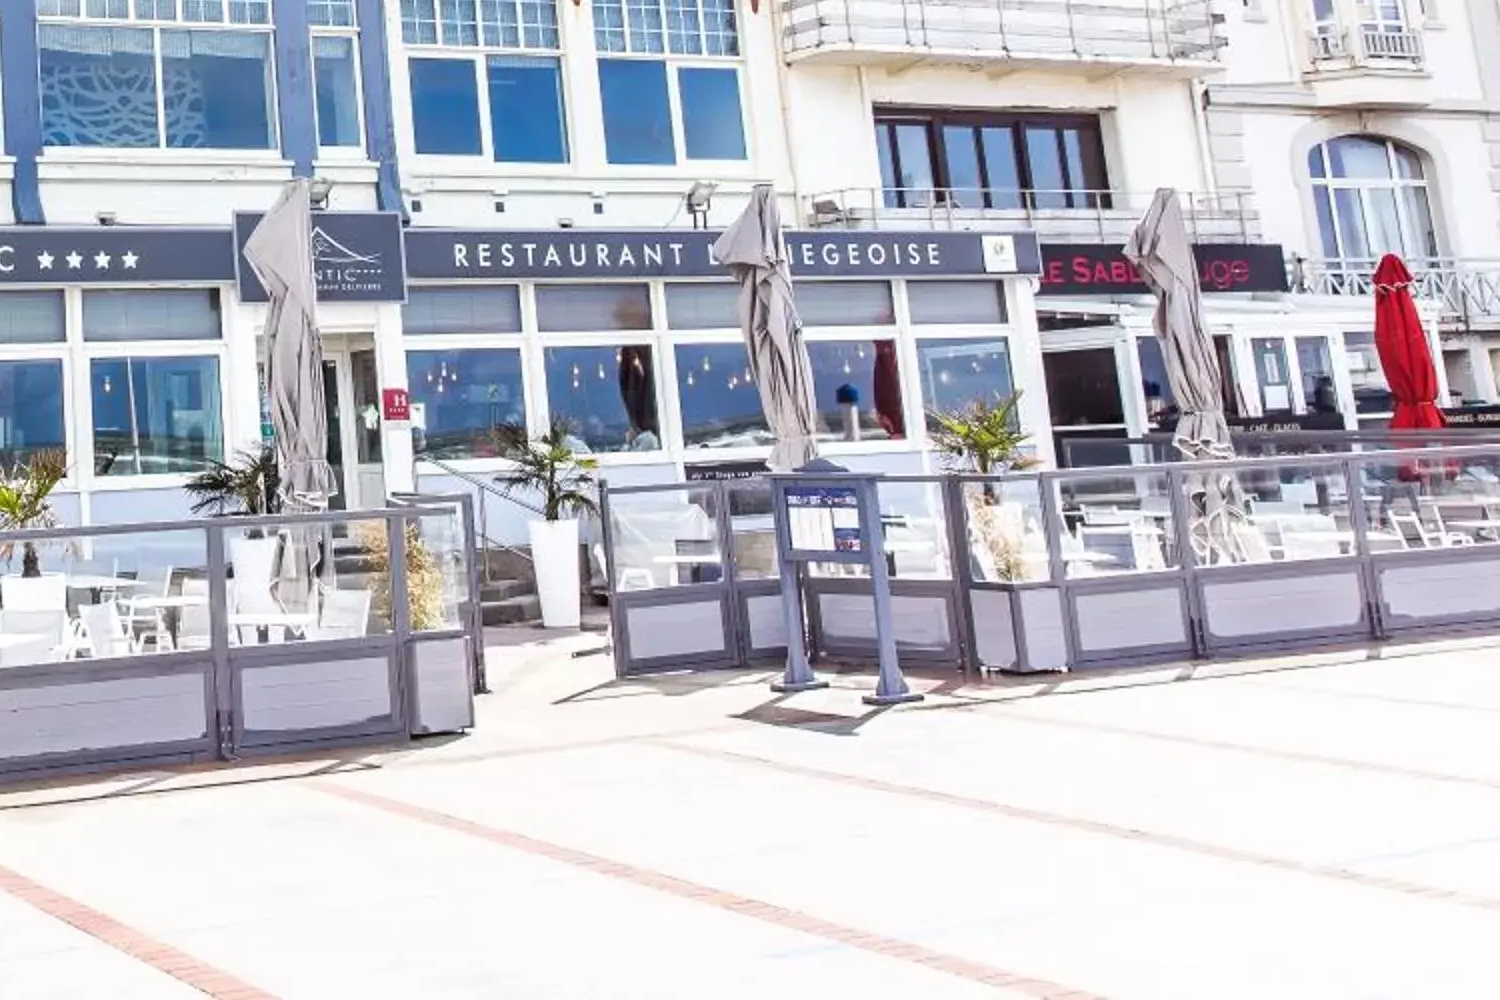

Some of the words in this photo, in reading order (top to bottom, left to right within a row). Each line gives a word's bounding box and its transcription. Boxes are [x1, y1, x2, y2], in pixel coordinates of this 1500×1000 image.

[453, 243, 684, 267] RESTAURANT
[787, 243, 941, 265] IEGEOISE
[1072, 257, 1145, 283] SABL
